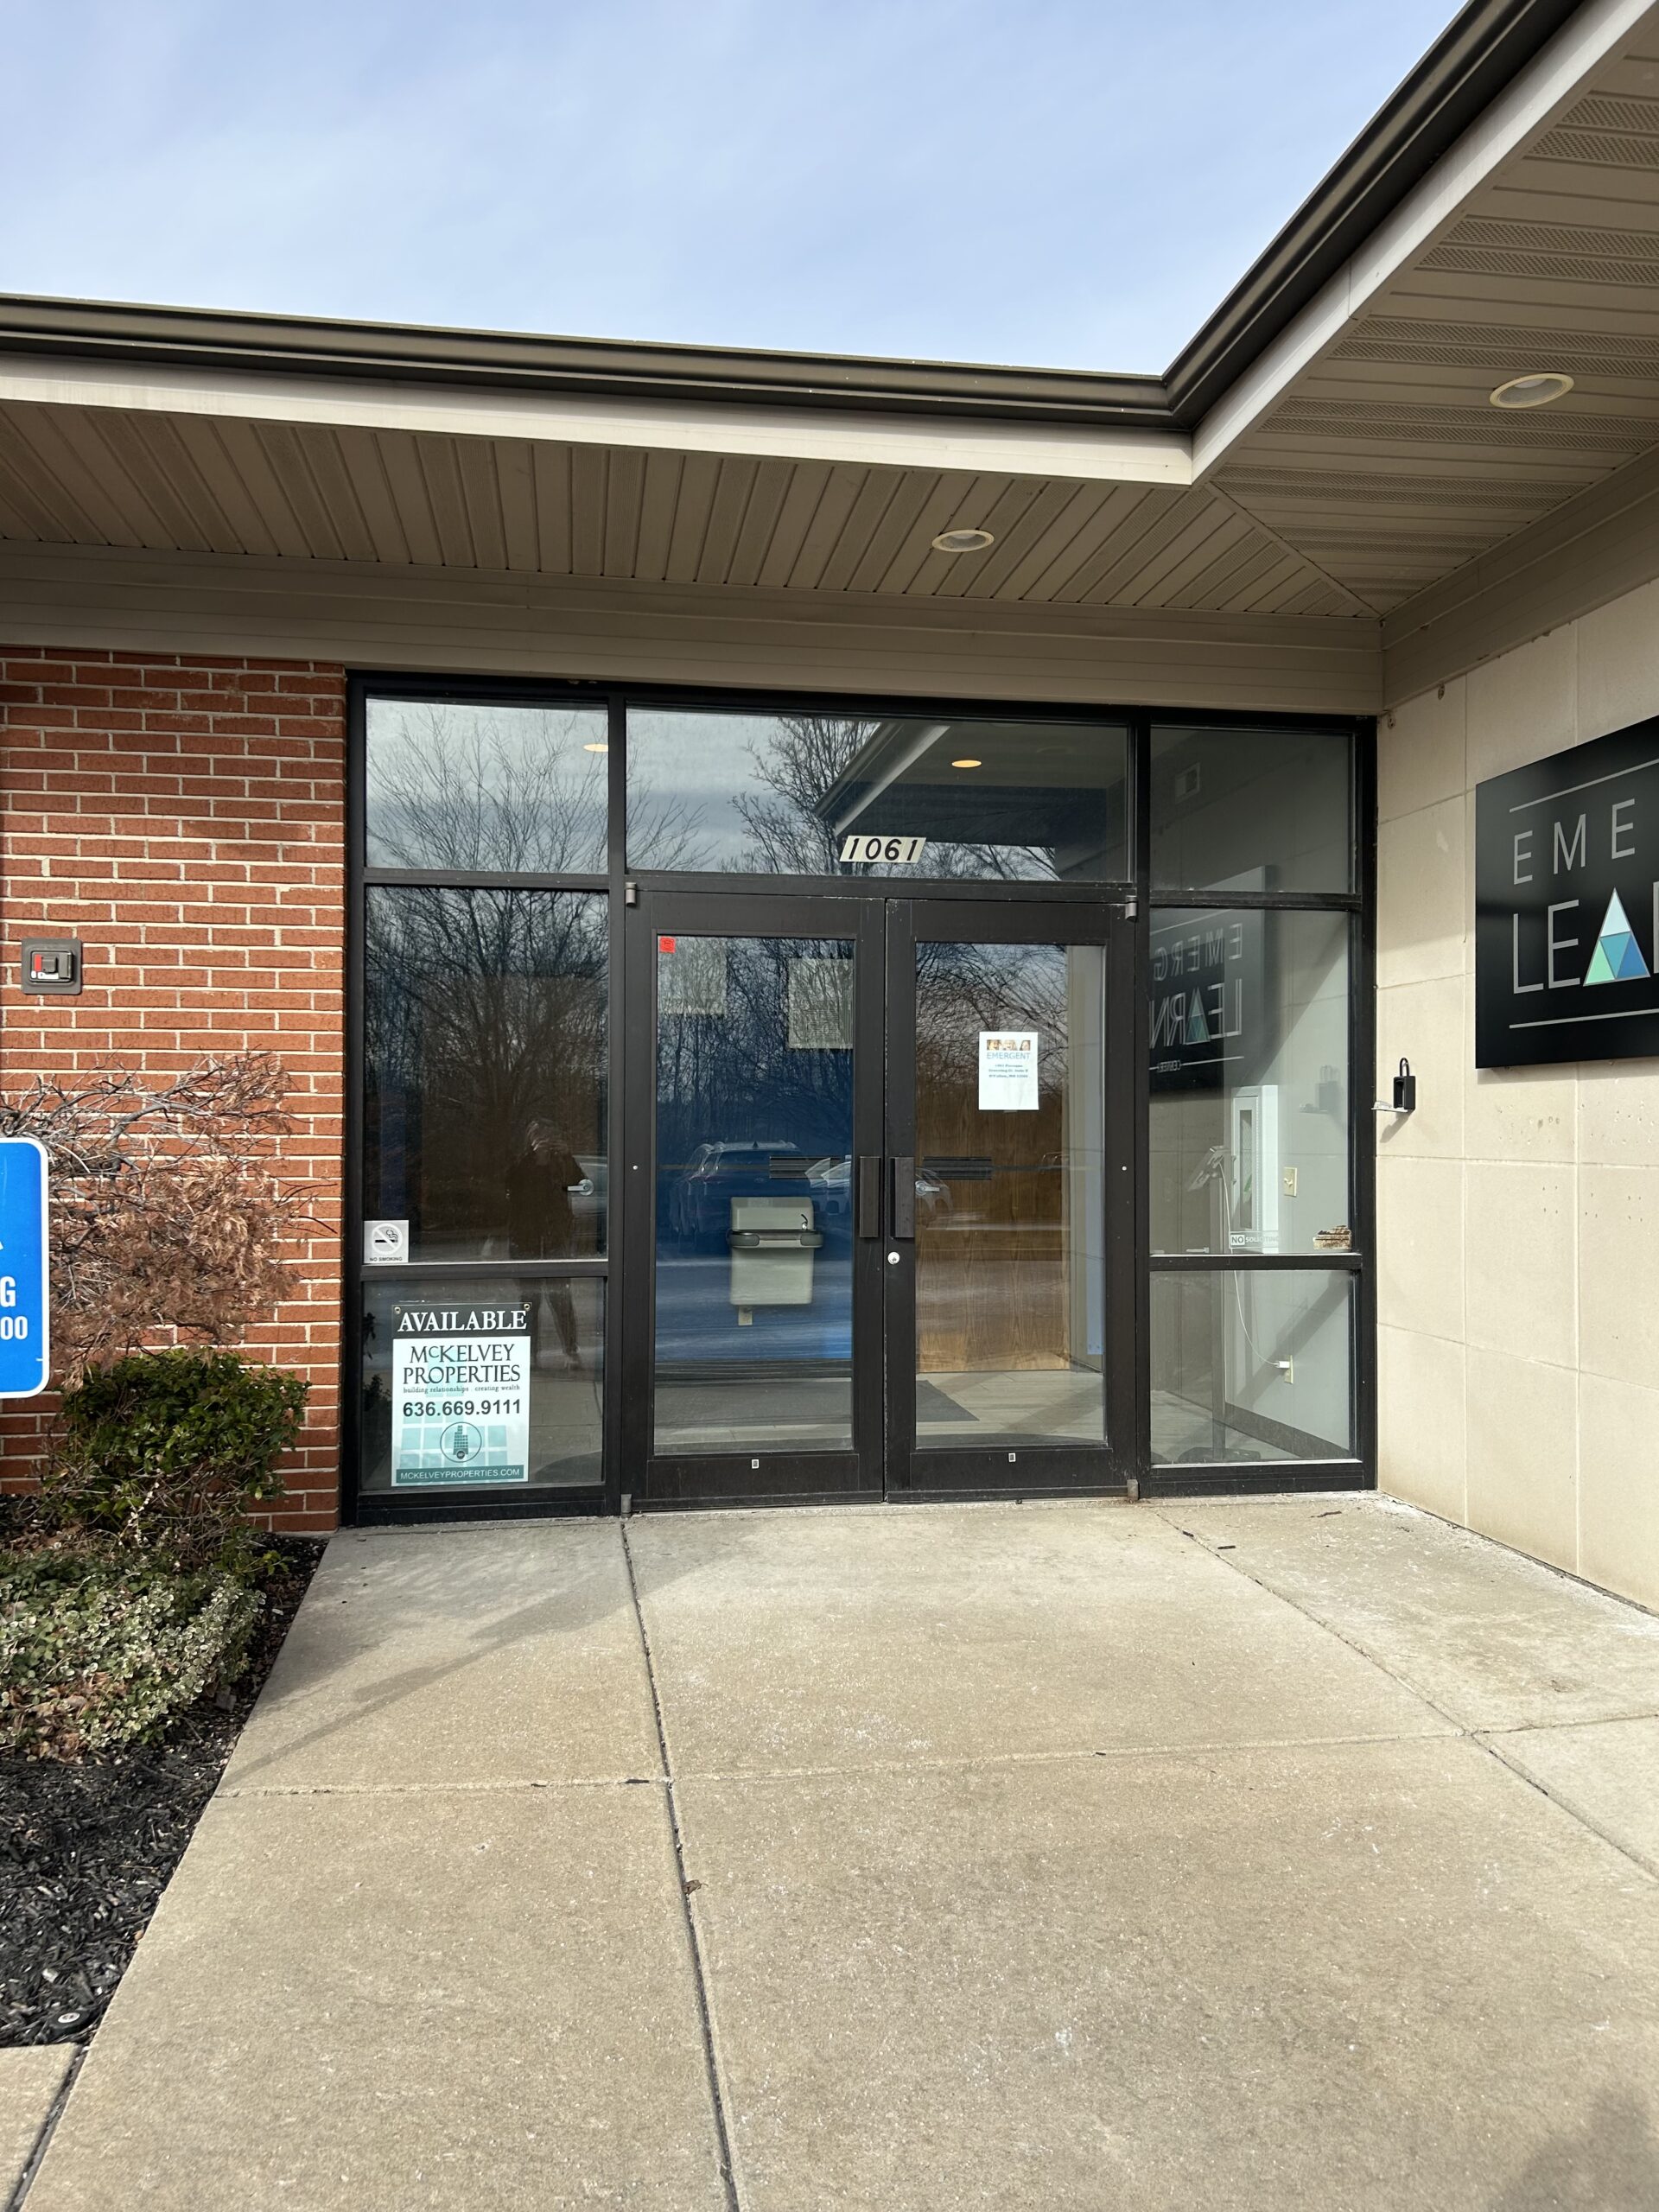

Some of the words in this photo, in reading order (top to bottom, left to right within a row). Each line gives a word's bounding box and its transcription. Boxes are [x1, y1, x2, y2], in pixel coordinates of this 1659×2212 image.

[848, 837, 918, 861] 1061
[1513, 881, 1659, 995] LEA
[1231, 1236, 1244, 1244] NO
[397, 1310, 527, 1332] AVAILABLE
[403, 1364, 521, 1385] PROPERTIES
[403, 1386, 429, 1395] building
[429, 1385, 469, 1394] relationships
[474, 1384, 499, 1393] creating
[403, 1399, 521, 1417] 636.669.9111
